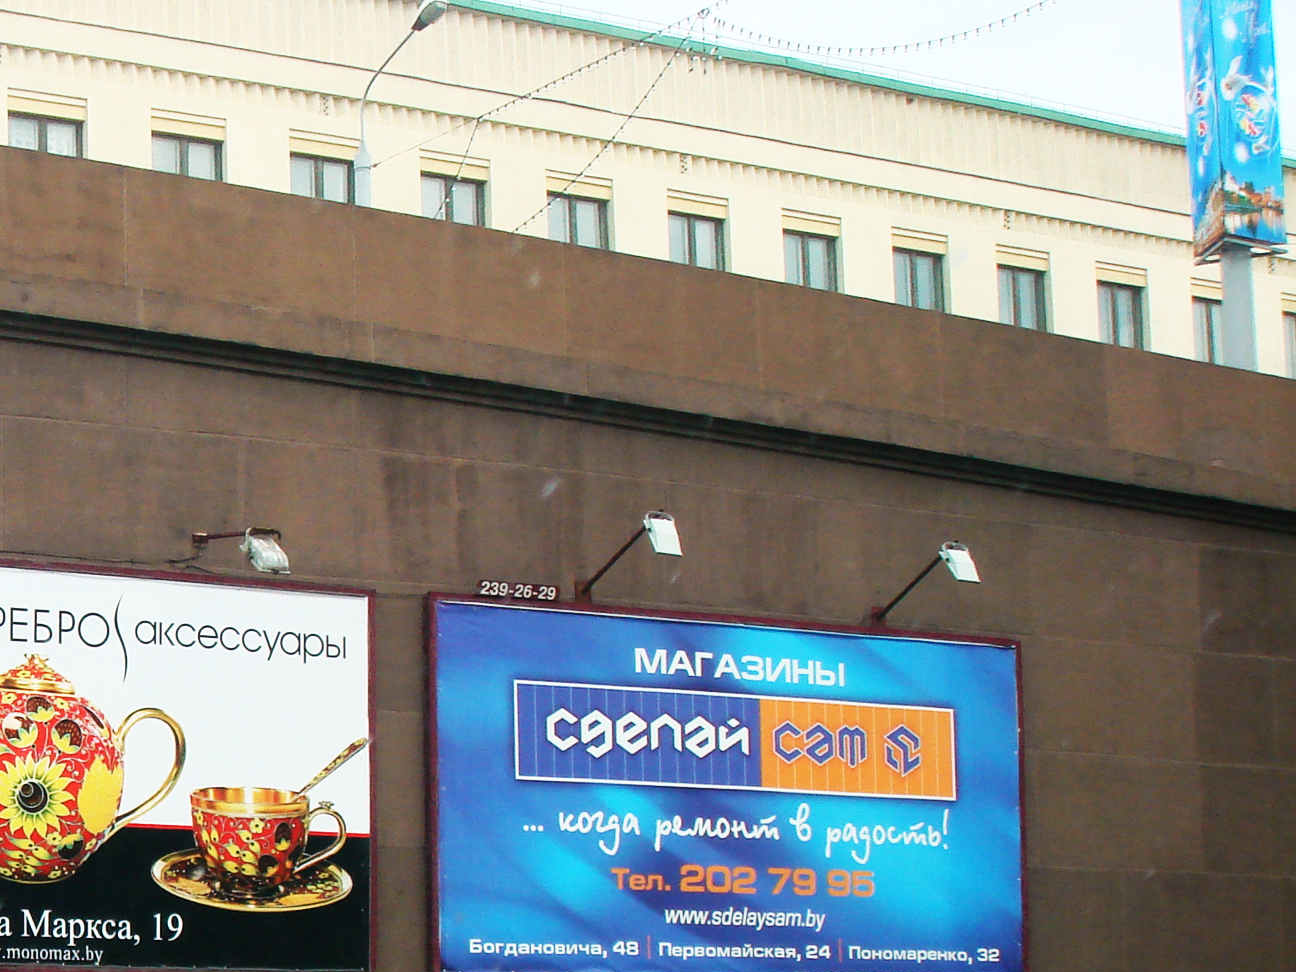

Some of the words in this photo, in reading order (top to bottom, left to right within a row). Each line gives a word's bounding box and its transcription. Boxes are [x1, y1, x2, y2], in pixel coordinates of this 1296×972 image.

[480, 581, 557, 601] 239-26-29
[135, 620, 347, 663] аксессуары
[634, 647, 845, 687] МАГАЗИНЫ
[546, 707, 750, 758] сделай
[773, 719, 867, 768] сам
[558, 811, 640, 855] когда
[655, 810, 780, 851] ремонт
[790, 803, 813, 842] в
[826, 809, 949, 864] радость!
[611, 867, 671, 892] Тел.
[680, 865, 757, 894] 202
[768, 868, 818, 897] 79
[827, 870, 876, 898] 95
[20, 908, 141, 946] Маркса,
[153, 912, 184, 942] 19
[664, 906, 826, 932] www.sdelaysam.by
[468, 937, 607, 959] Богдановича,
[612, 940, 640, 957] 48
[657, 941, 802, 963] Первомайская,
[805, 944, 832, 961] 24
[847, 945, 973, 964] Пономаренко,
[976, 946, 1001, 964] 32
